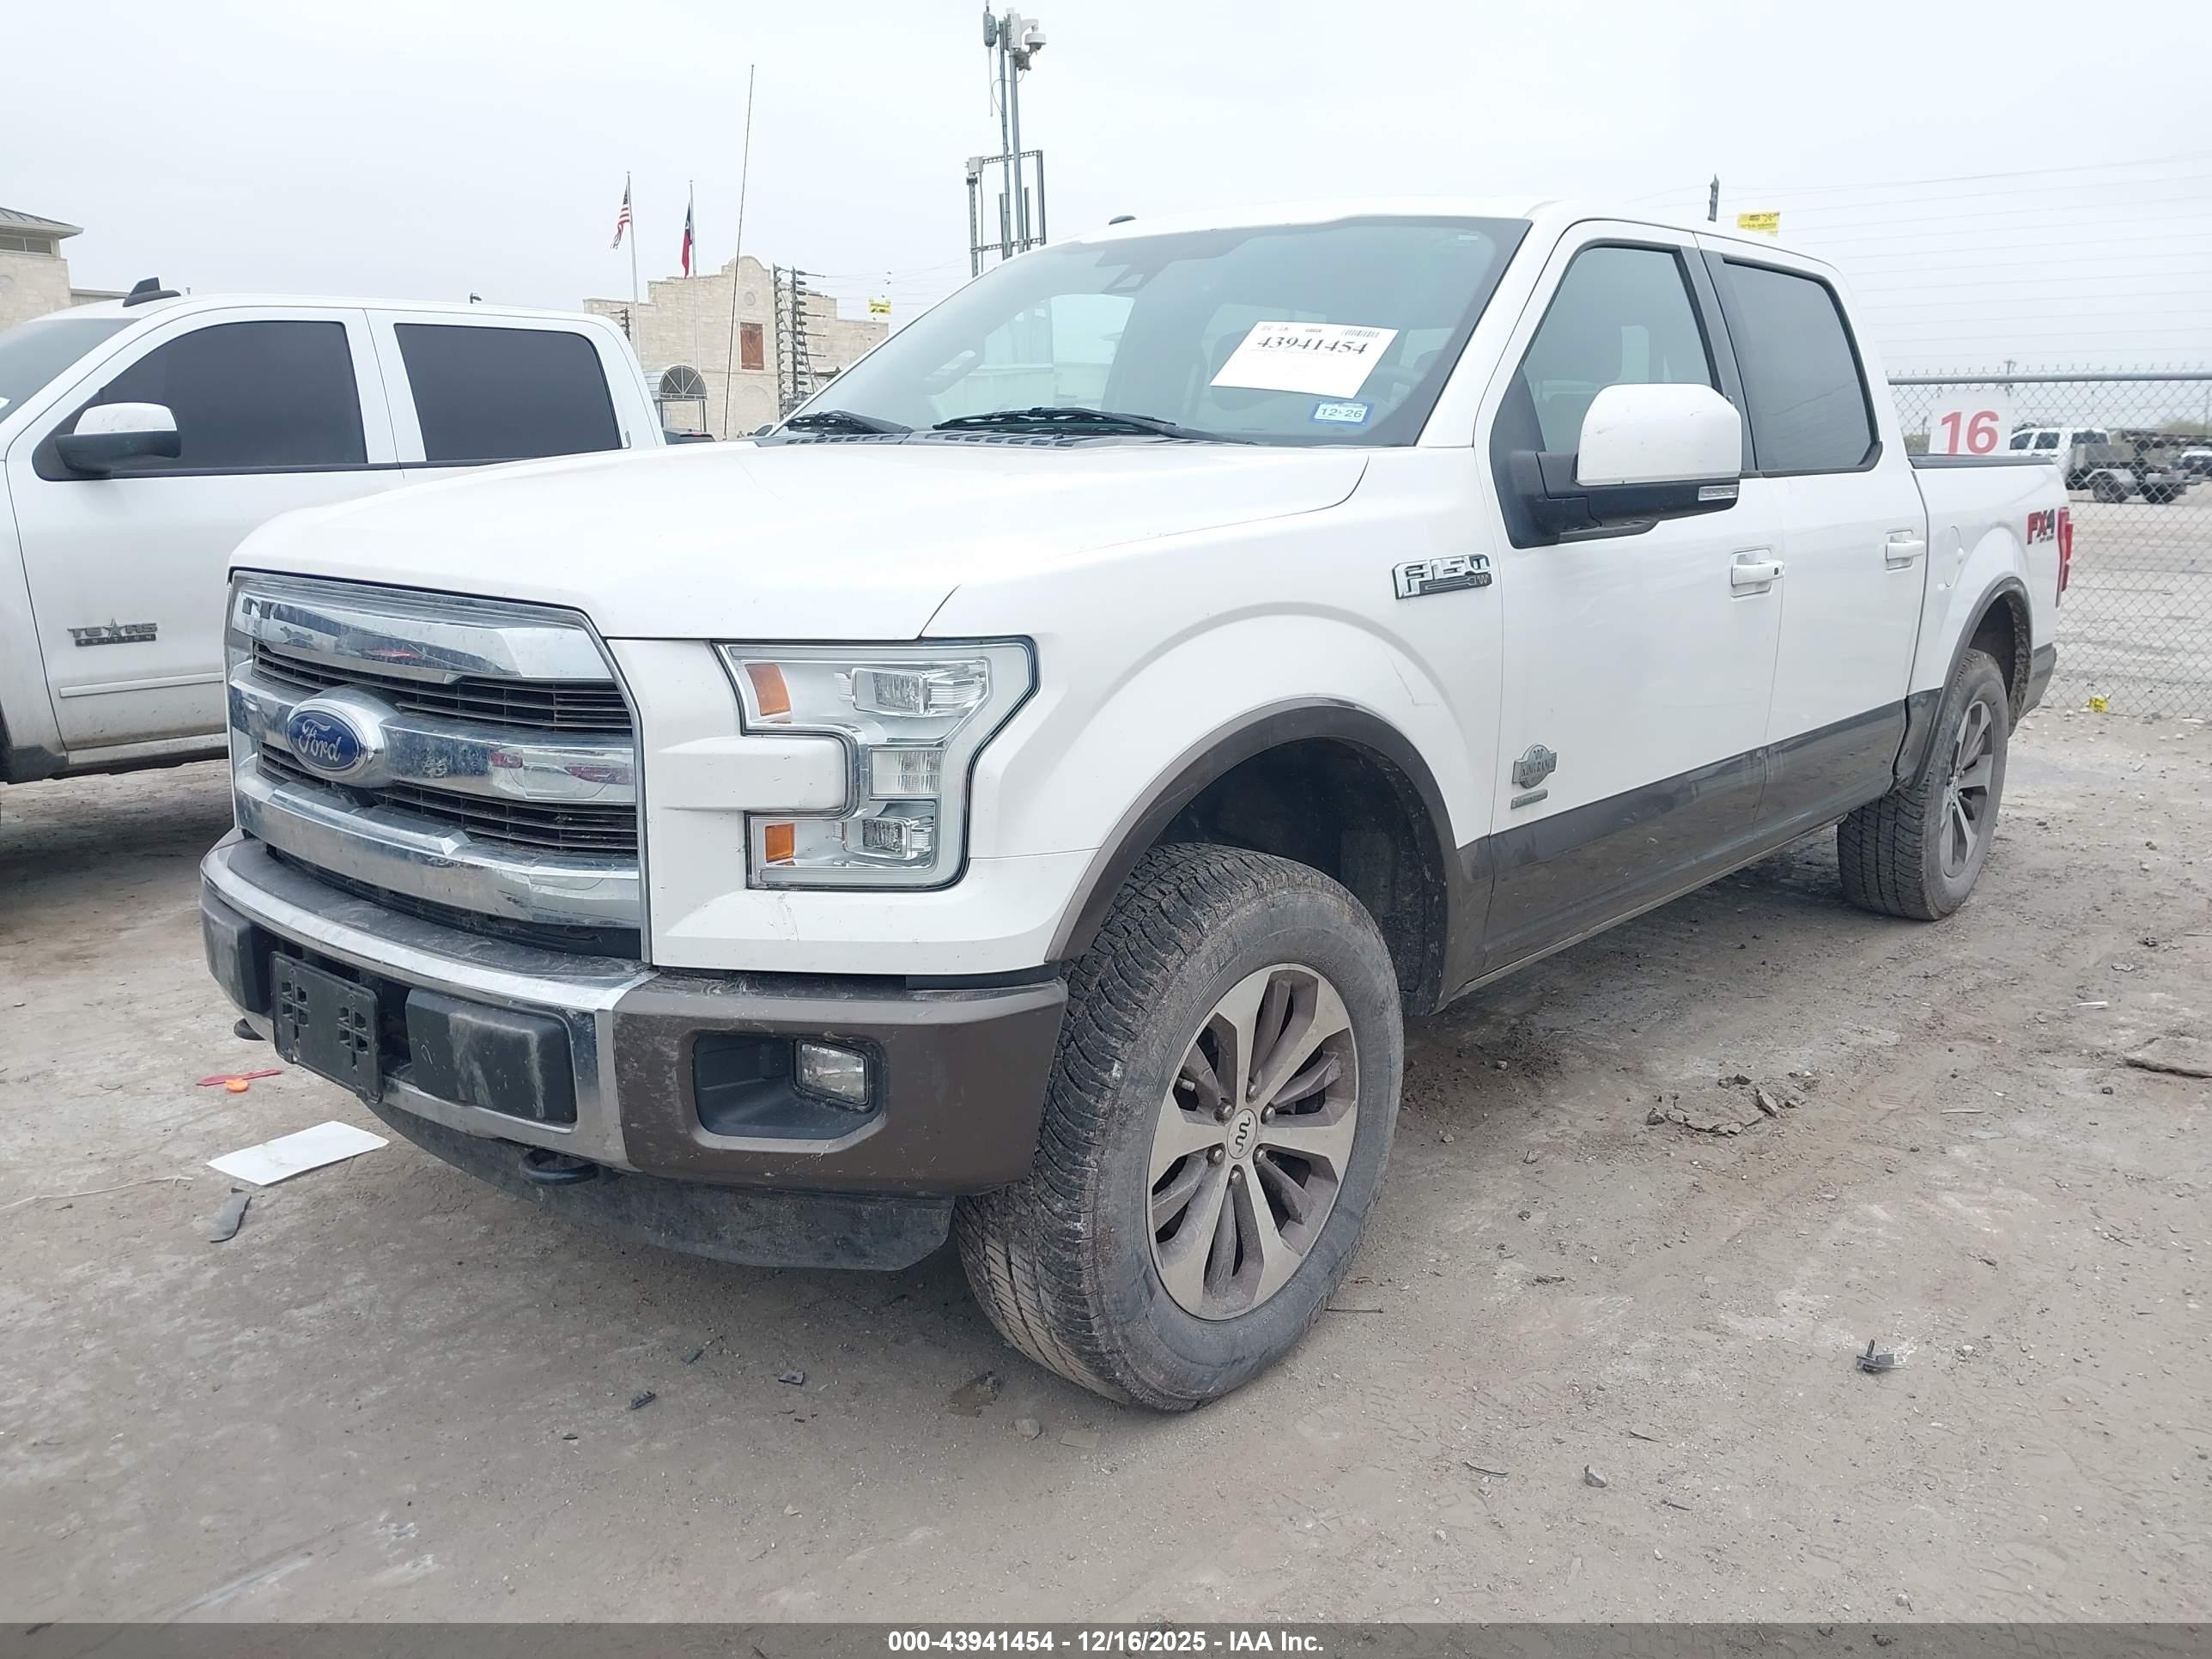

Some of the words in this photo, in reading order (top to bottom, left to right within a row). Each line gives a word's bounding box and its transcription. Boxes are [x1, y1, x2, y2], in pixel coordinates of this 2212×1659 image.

[1256, 336, 1369, 355] 43941454
[1321, 408, 1339, 417] 12
[1344, 409, 1364, 418] 26
[1941, 410, 2000, 455] 16
[2027, 508, 2055, 544] FX4
[298, 719, 342, 762] Ford
